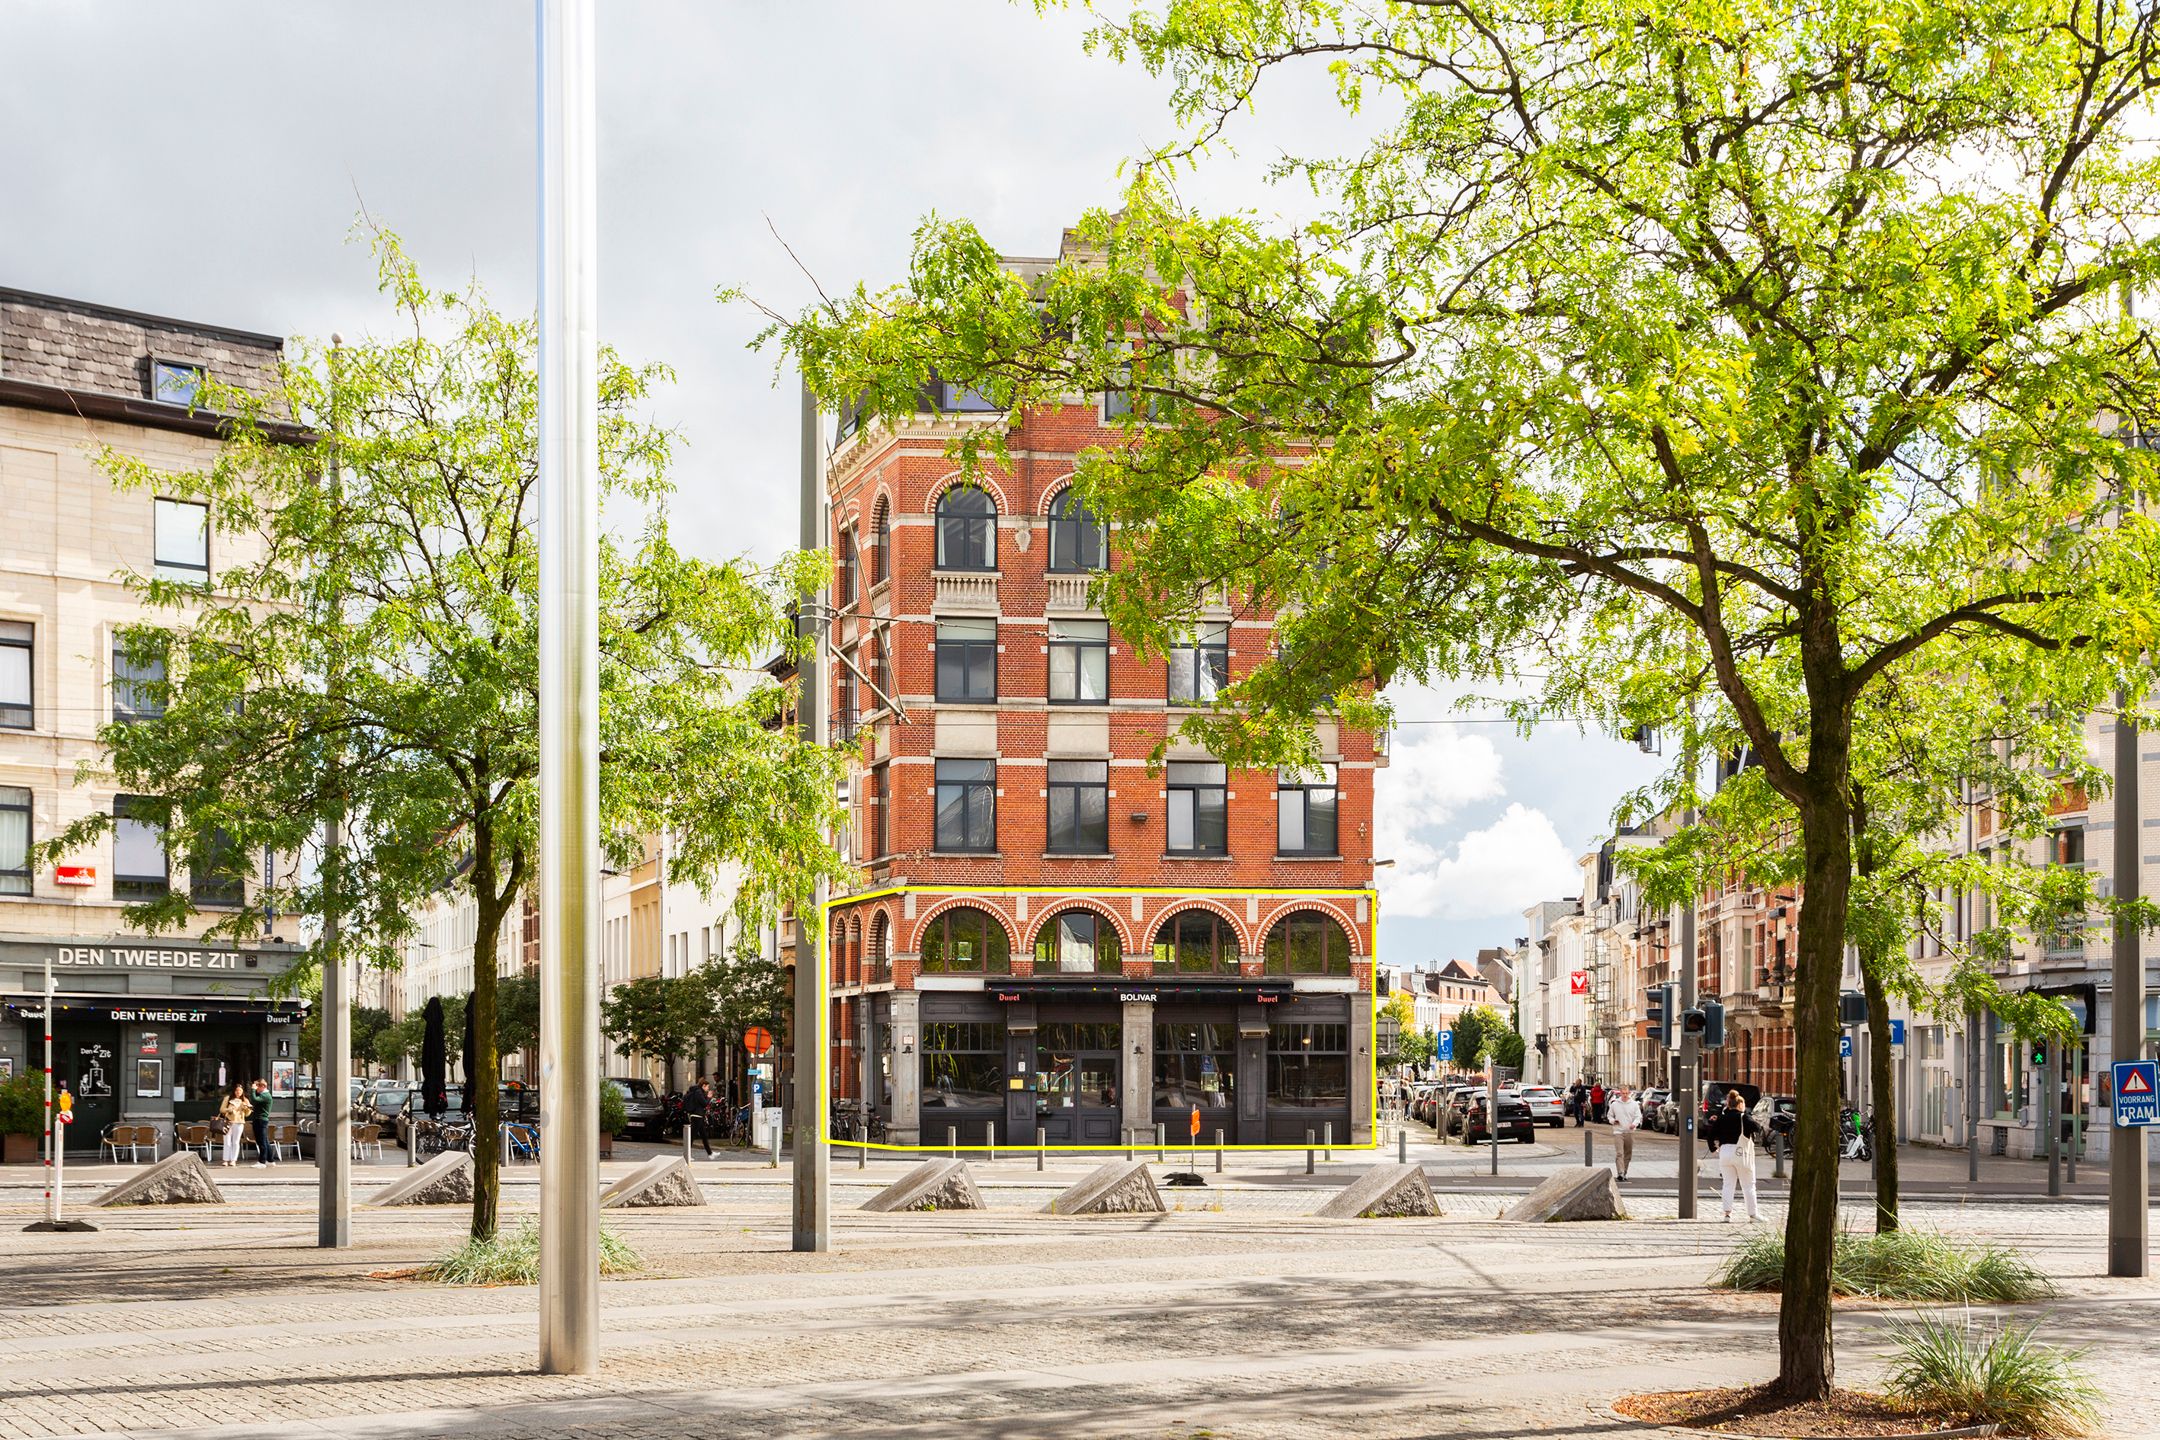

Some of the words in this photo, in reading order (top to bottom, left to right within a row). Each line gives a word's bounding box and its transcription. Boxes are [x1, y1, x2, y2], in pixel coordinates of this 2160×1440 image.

[58, 948, 104, 965] DEN
[110, 949, 202, 968] TWEEDE
[207, 952, 240, 969] ZIT
[999, 993, 1020, 1001] Duvel
[1120, 993, 1157, 1002] BOLIVAR
[1257, 994, 1278, 1003] Duvel
[111, 1010, 136, 1021] DEN
[139, 1011, 187, 1022] TWEEDE
[189, 1012, 208, 1023] ZIT
[266, 1014, 290, 1023] Duvel
[1440, 1032, 1450, 1047] P
[80, 1047, 93, 1055] Den
[99, 1049, 112, 1059] Zit
[1839, 1040, 1850, 1055] P
[753, 1083, 760, 1093] P
[2119, 1095, 2155, 1104] VOORRANG
[2120, 1106, 2154, 1119] TRAM
